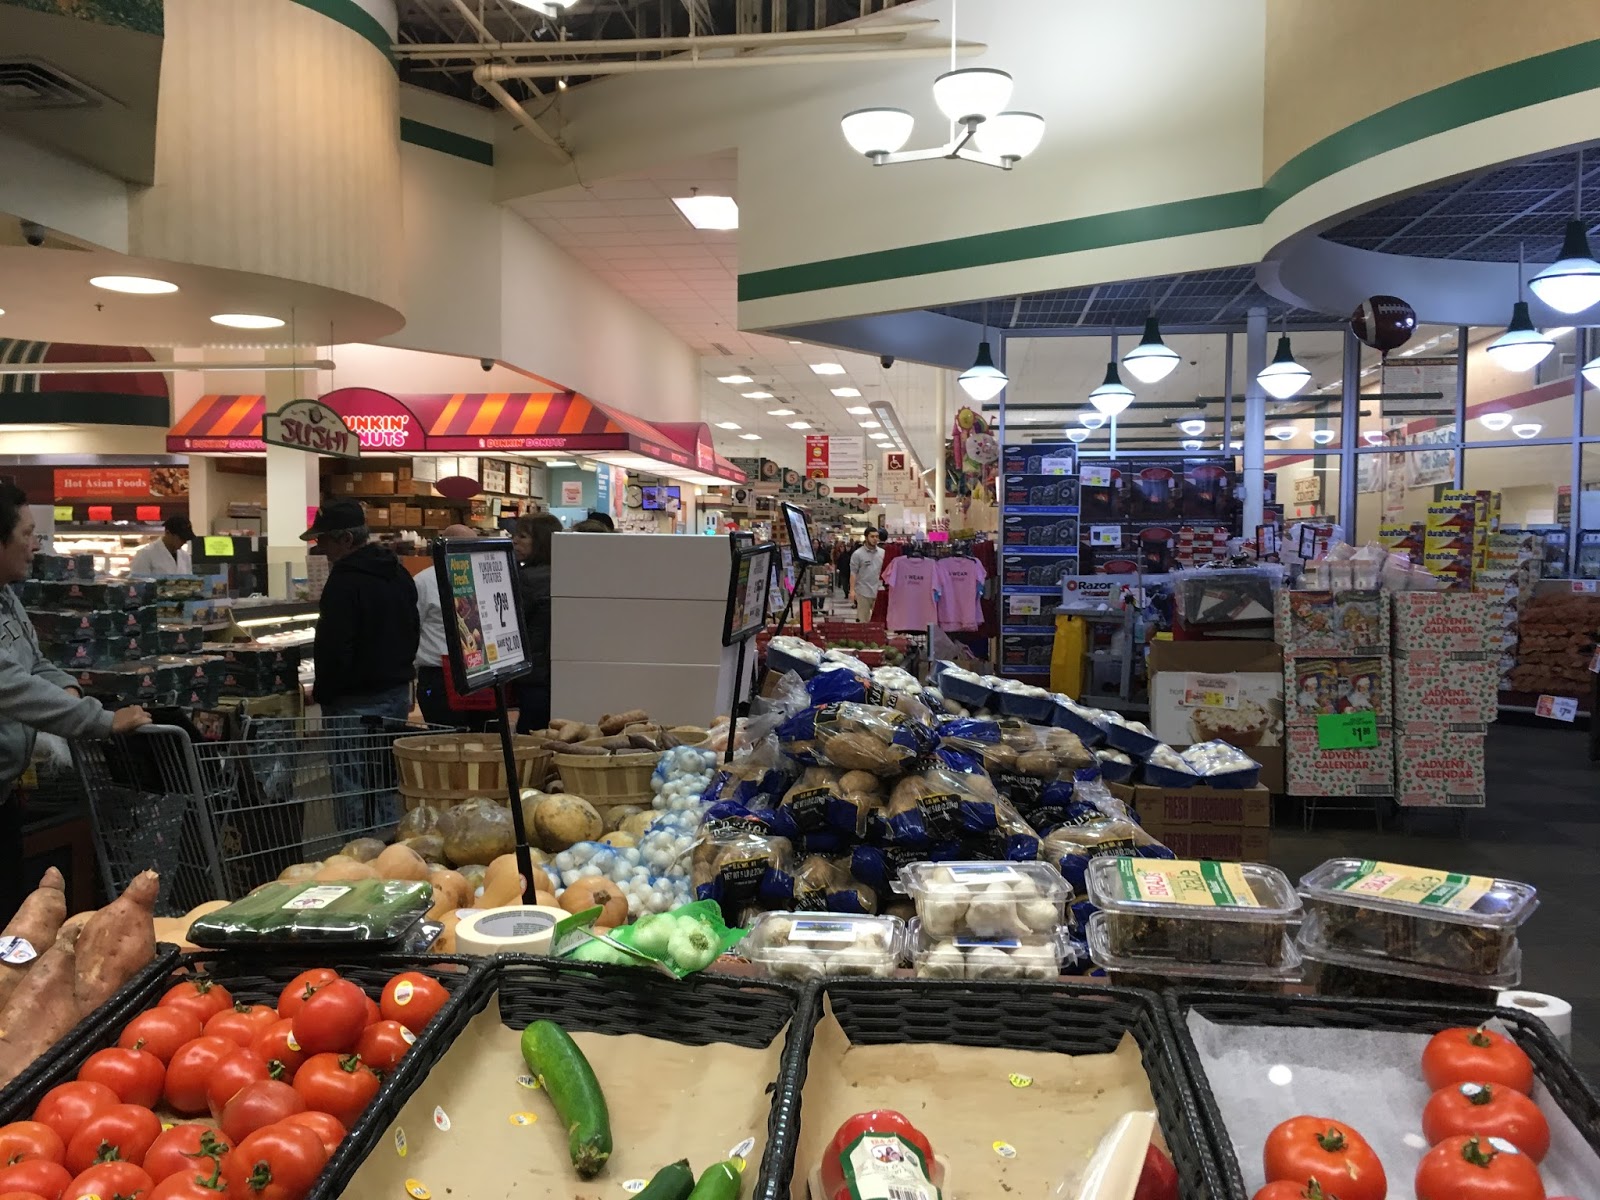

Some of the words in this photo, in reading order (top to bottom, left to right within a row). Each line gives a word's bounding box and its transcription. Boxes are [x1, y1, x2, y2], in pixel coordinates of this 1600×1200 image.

[342, 415, 409, 431] UNKIN'
[281, 419, 348, 453] SUSHI
[356, 431, 405, 447] NUTS
[487, 438, 525, 447] DUNKIN'
[525, 438, 566, 447] DONUTS
[766, 465, 773, 473] 4
[789, 474, 795, 482] 5
[64, 479, 82, 488] Hot
[86, 479, 114, 488] Asian
[117, 479, 147, 488] Foods
[1443, 493, 1477, 501] duraflame
[1427, 506, 1461, 514] duraflame
[1379, 529, 1411, 537] duraflame
[450, 558, 470, 576] Always
[1078, 581, 1114, 590] Razor
[1423, 626, 1474, 634] CALENDAR
[1428, 689, 1466, 697] ADVENT
[1421, 698, 1472, 706] CALENDAR
[1320, 751, 1363, 760] ADVENT
[1314, 760, 1370, 770] CALENDAR
[1423, 760, 1465, 769] ADVENT
[1415, 770, 1474, 779] CALENDAR
[1177, 870, 1206, 892] kale
